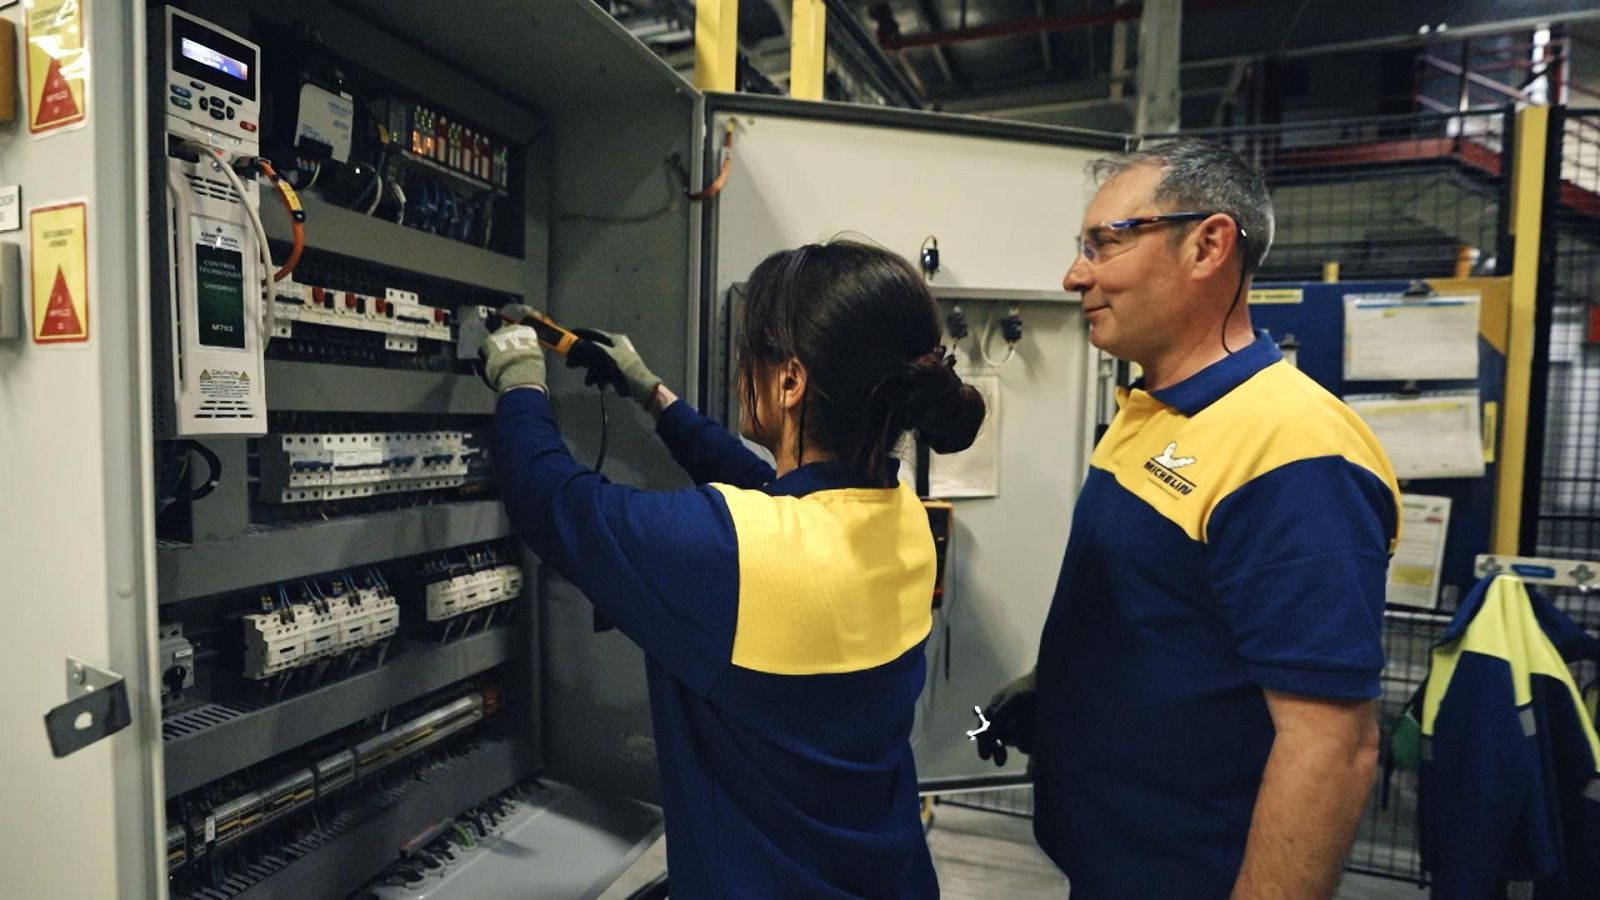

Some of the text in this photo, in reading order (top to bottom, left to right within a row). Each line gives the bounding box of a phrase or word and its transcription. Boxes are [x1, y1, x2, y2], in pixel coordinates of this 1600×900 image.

[202, 260, 236, 271] CONTROL
[199, 265, 241, 279] TECHNIQUES
[211, 323, 234, 332] M702
[1143, 461, 1193, 496] MICHELIN
